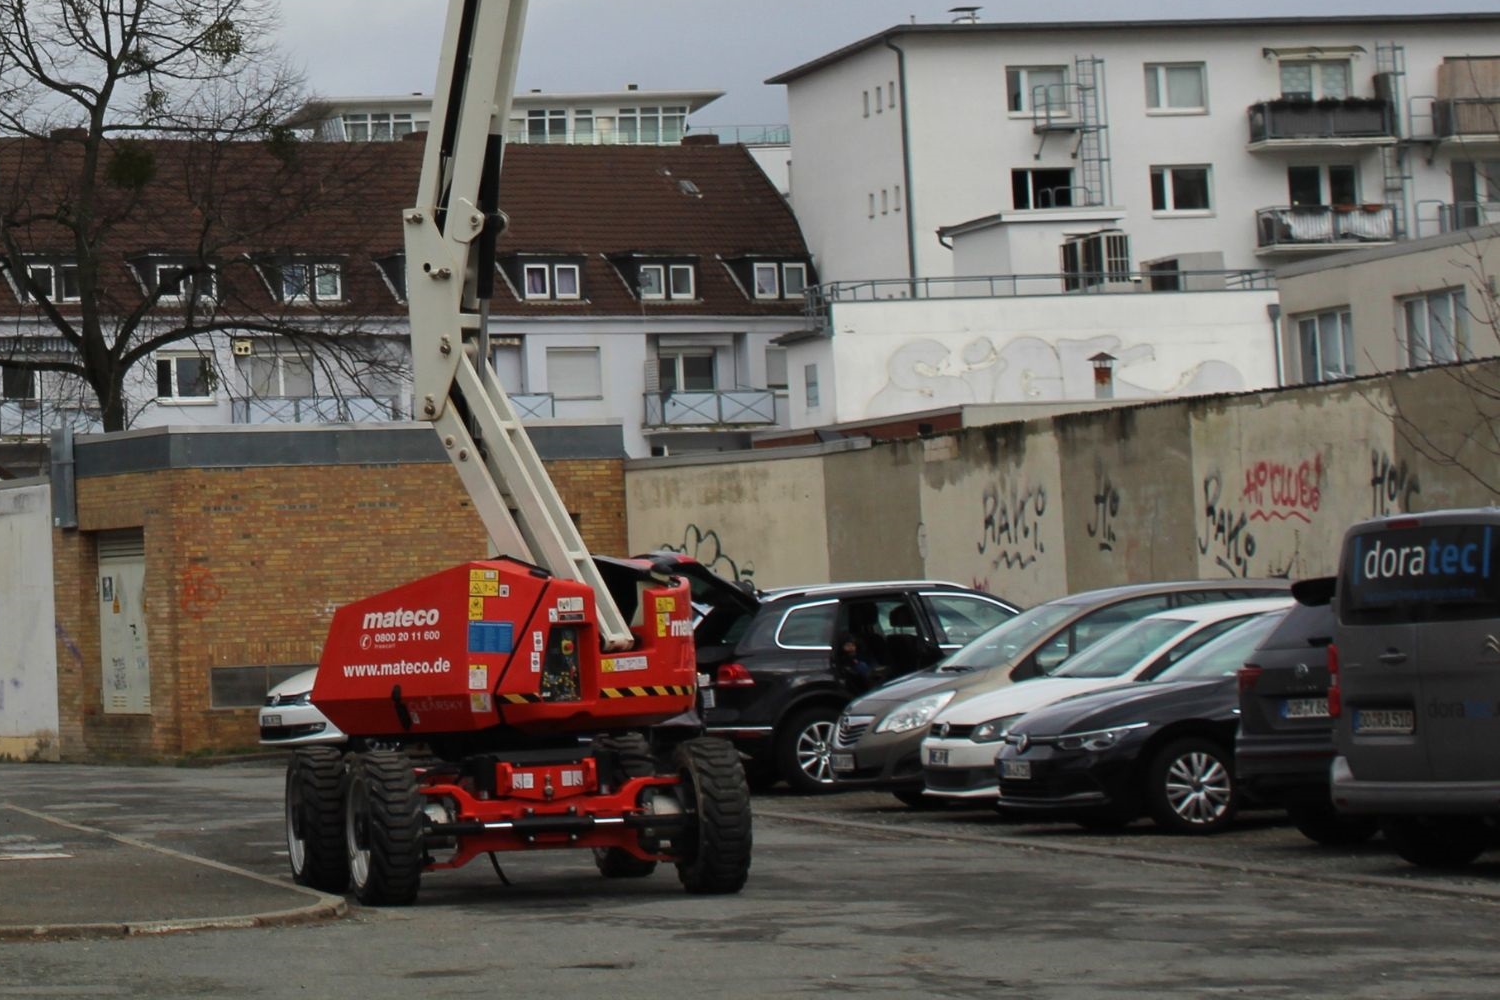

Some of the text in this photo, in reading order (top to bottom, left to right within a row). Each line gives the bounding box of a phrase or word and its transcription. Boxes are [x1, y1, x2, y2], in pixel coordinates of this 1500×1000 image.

[1364, 537, 1478, 580] doratec
[362, 607, 440, 629] mateco
[374, 630, 440, 642] 0800 20 11 600
[343, 657, 451, 678] www.mateco.de
